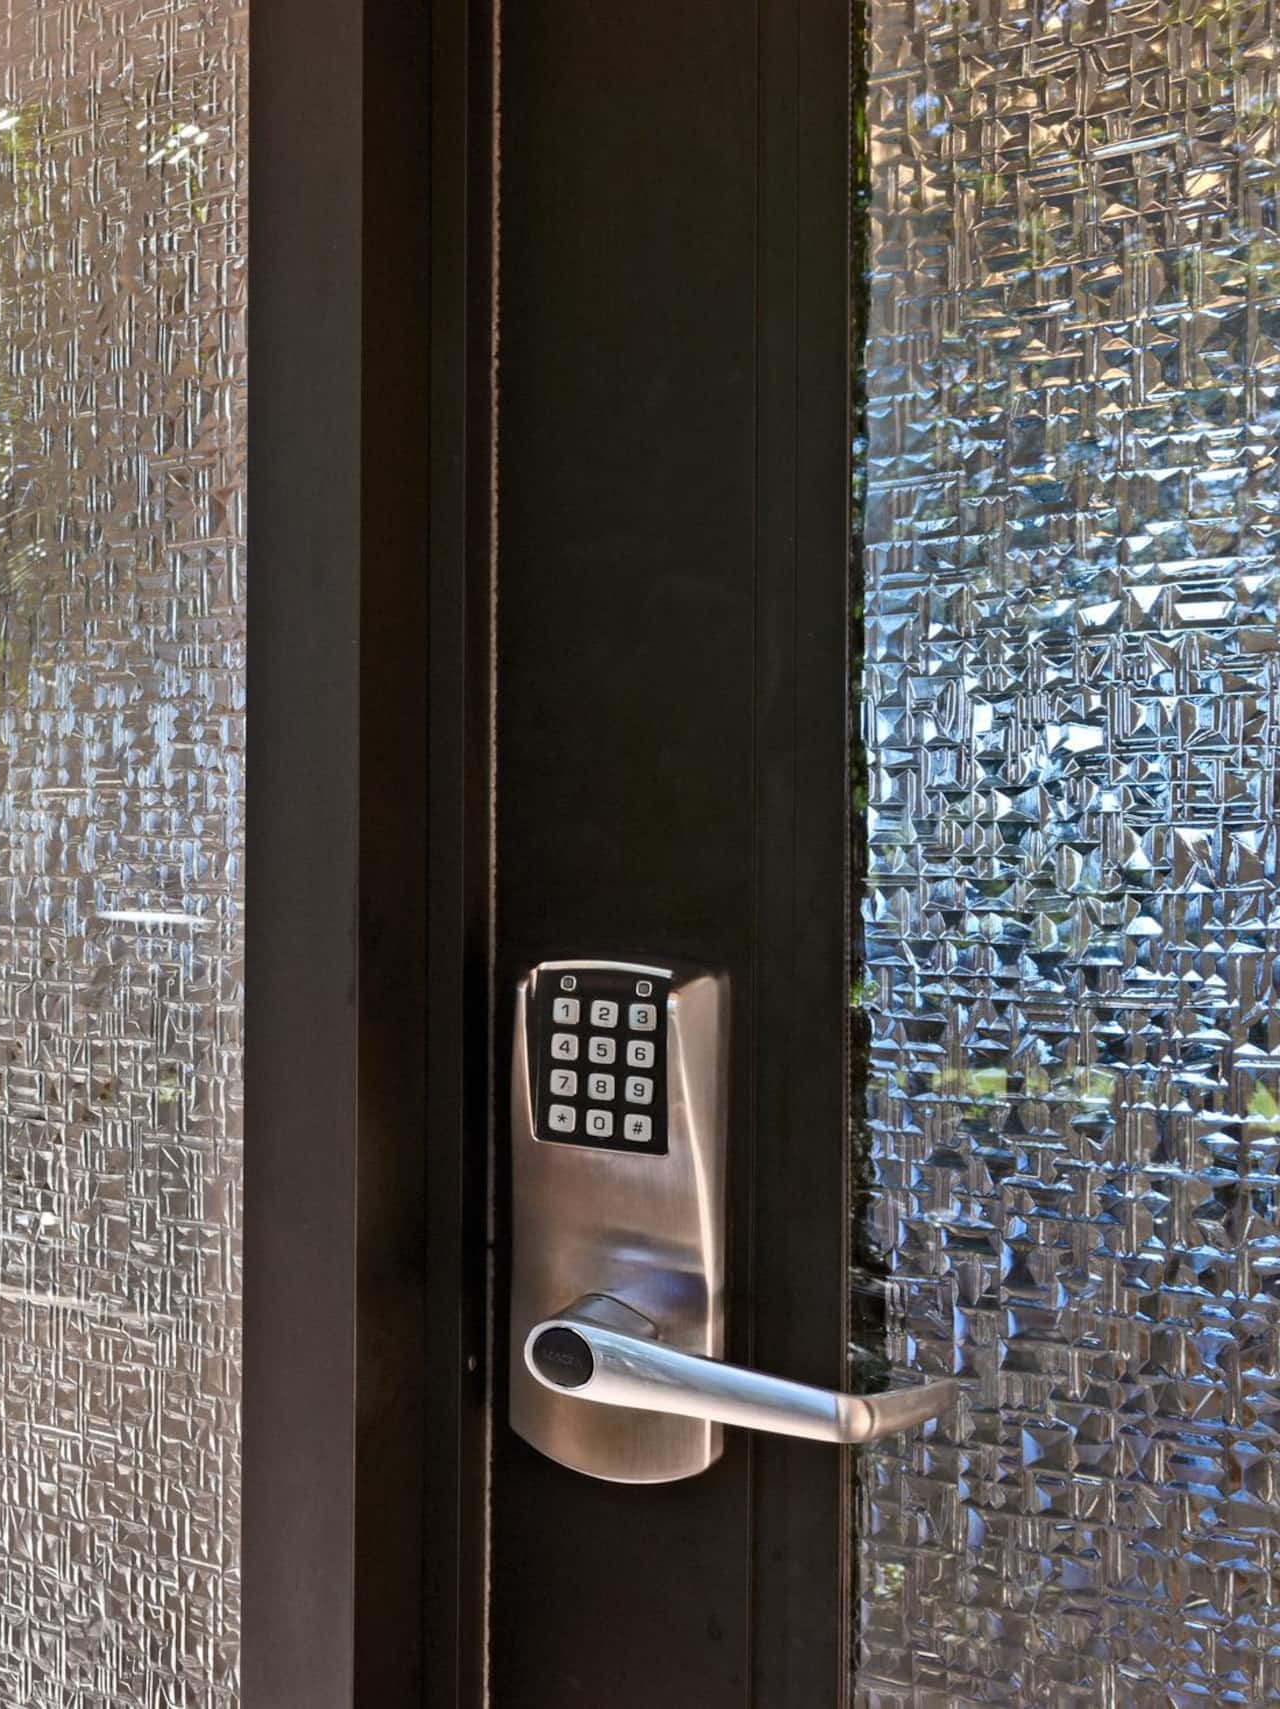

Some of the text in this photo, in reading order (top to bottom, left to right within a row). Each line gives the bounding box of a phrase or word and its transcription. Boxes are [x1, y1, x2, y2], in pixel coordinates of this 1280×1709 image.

[598, 1006, 611, 1021] 2
[636, 1010, 649, 1025] 3
[558, 1040, 647, 1061] 4 5 6
[558, 1075, 645, 1097] 7 8 9
[631, 1120, 644, 1135] #
